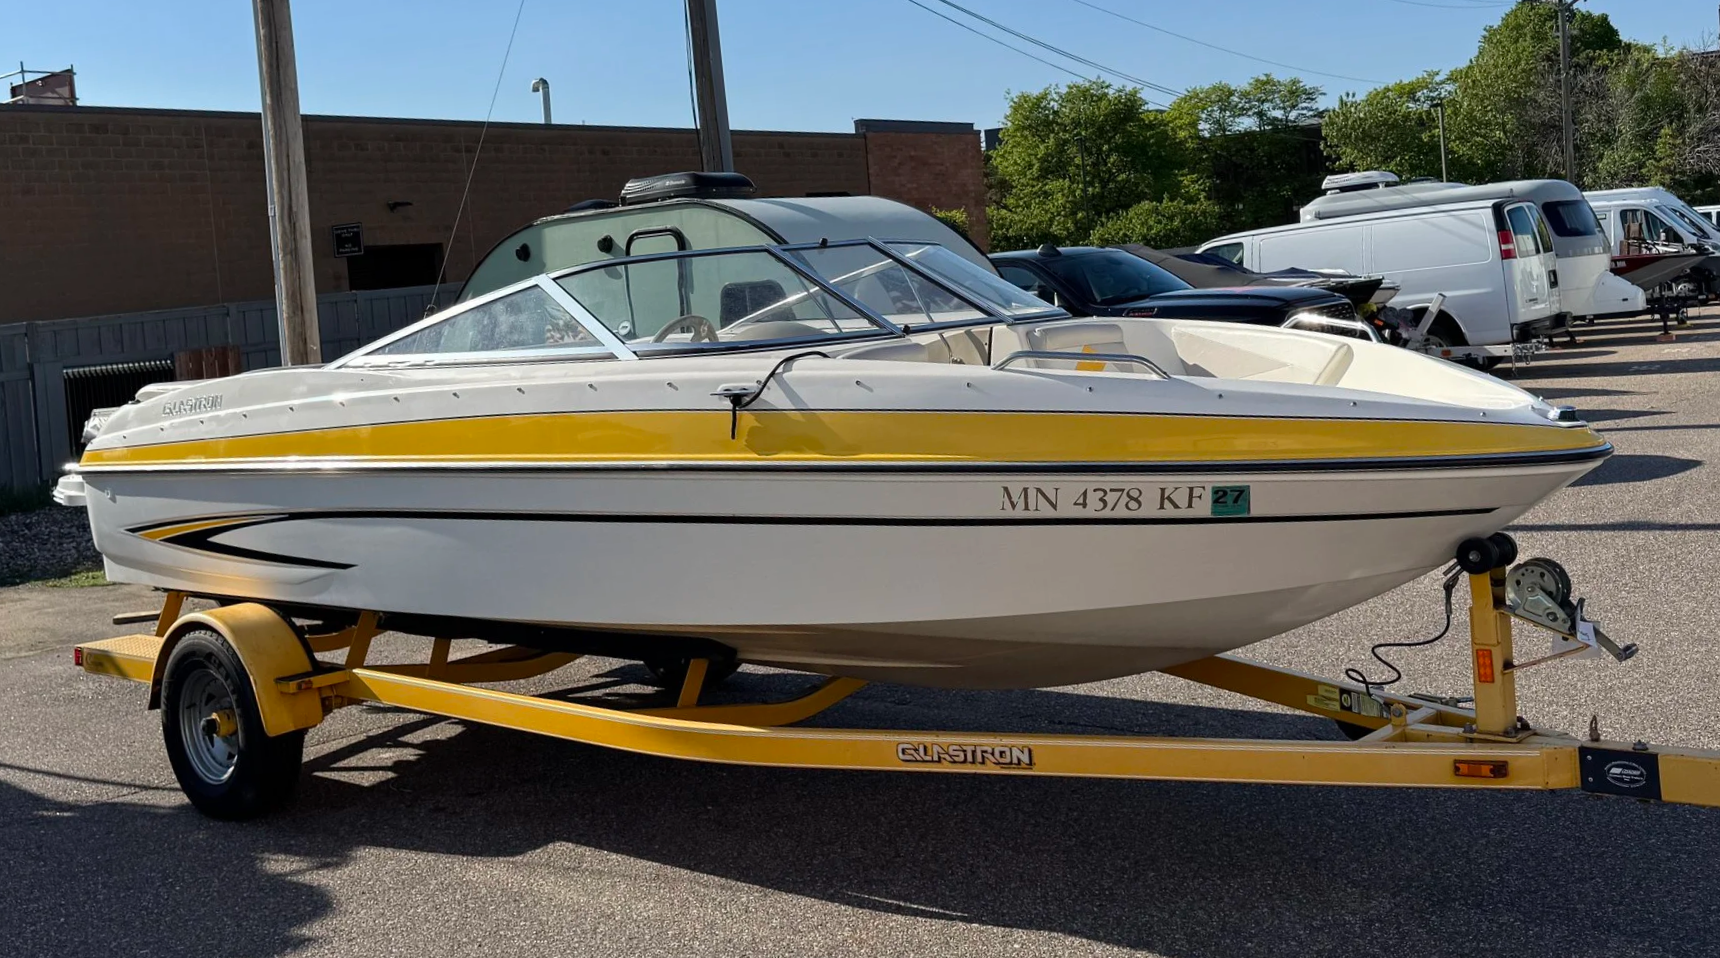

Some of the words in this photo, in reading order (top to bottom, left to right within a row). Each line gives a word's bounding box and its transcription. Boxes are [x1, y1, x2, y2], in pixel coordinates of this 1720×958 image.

[162, 394, 223, 417] GLASTRON
[1000, 486, 1060, 512] MN
[1073, 487, 1143, 512] 4378
[1157, 485, 1206, 510] KF
[1212, 489, 1246, 505] 27
[897, 743, 1034, 766] GLASTRON
